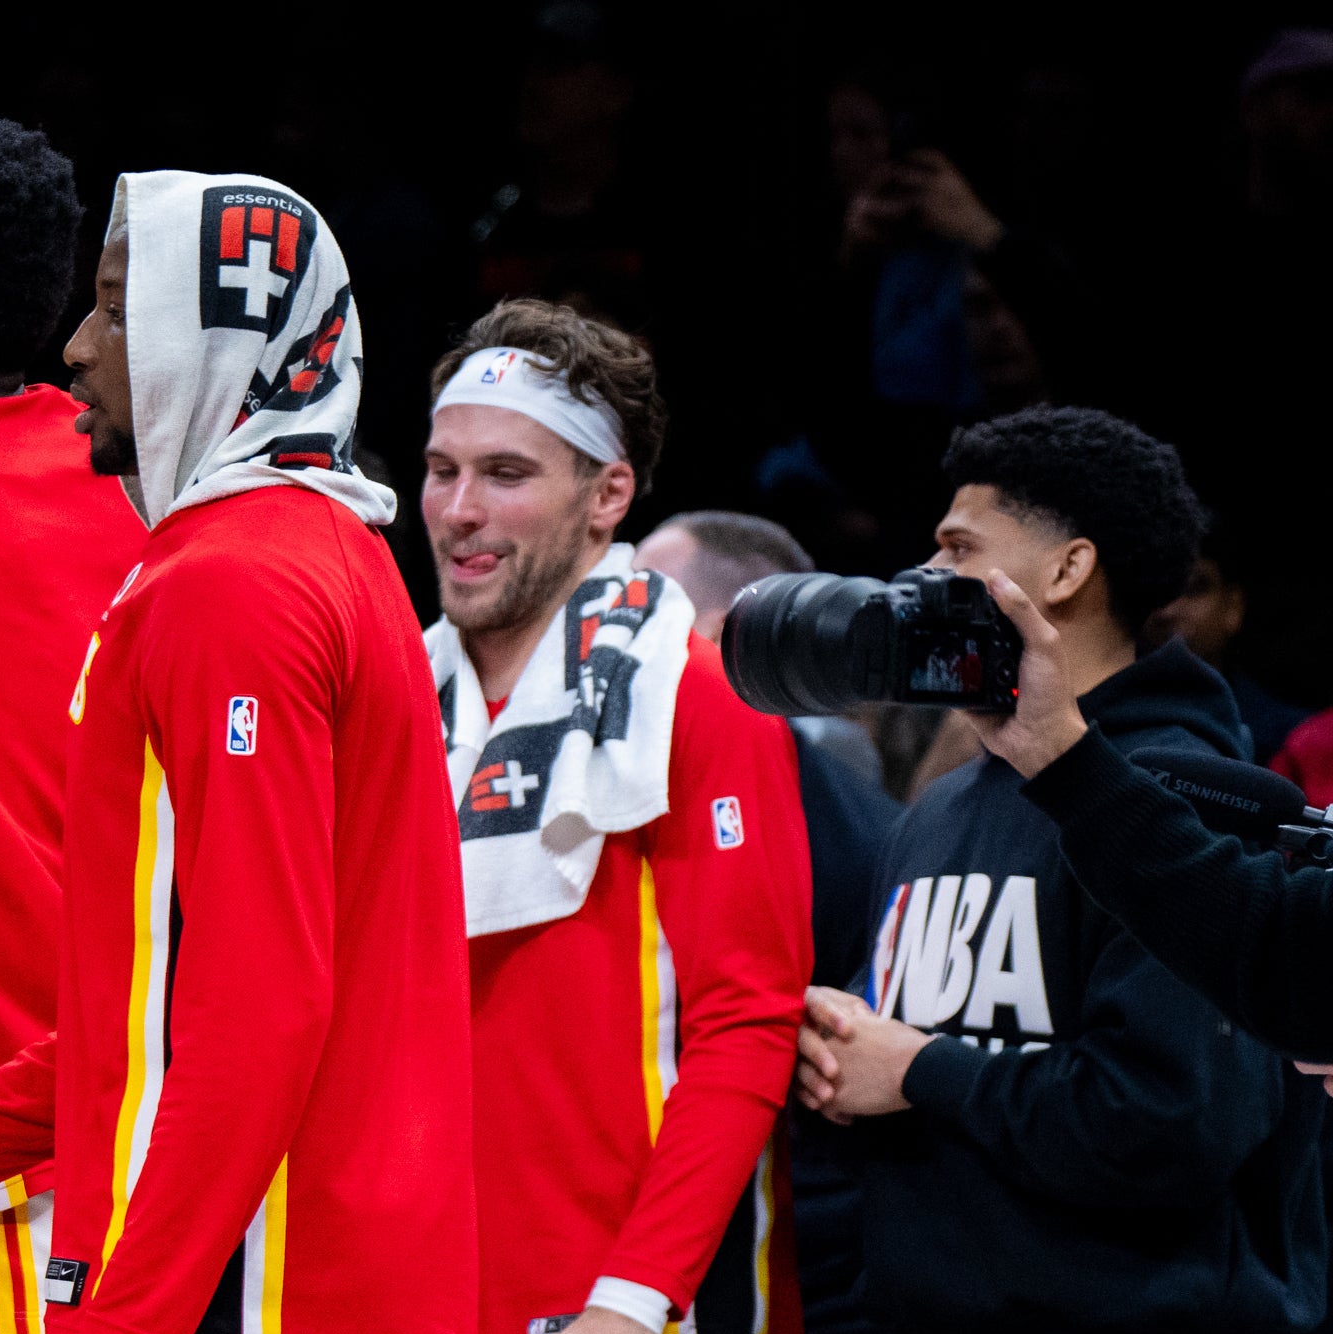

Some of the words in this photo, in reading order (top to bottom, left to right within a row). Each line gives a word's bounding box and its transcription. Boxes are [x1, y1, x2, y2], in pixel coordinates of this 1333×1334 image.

[222, 193, 303, 217] essentia
[1173, 777, 1262, 814] SENNHEISER
[877, 873, 1055, 1035] NBA
